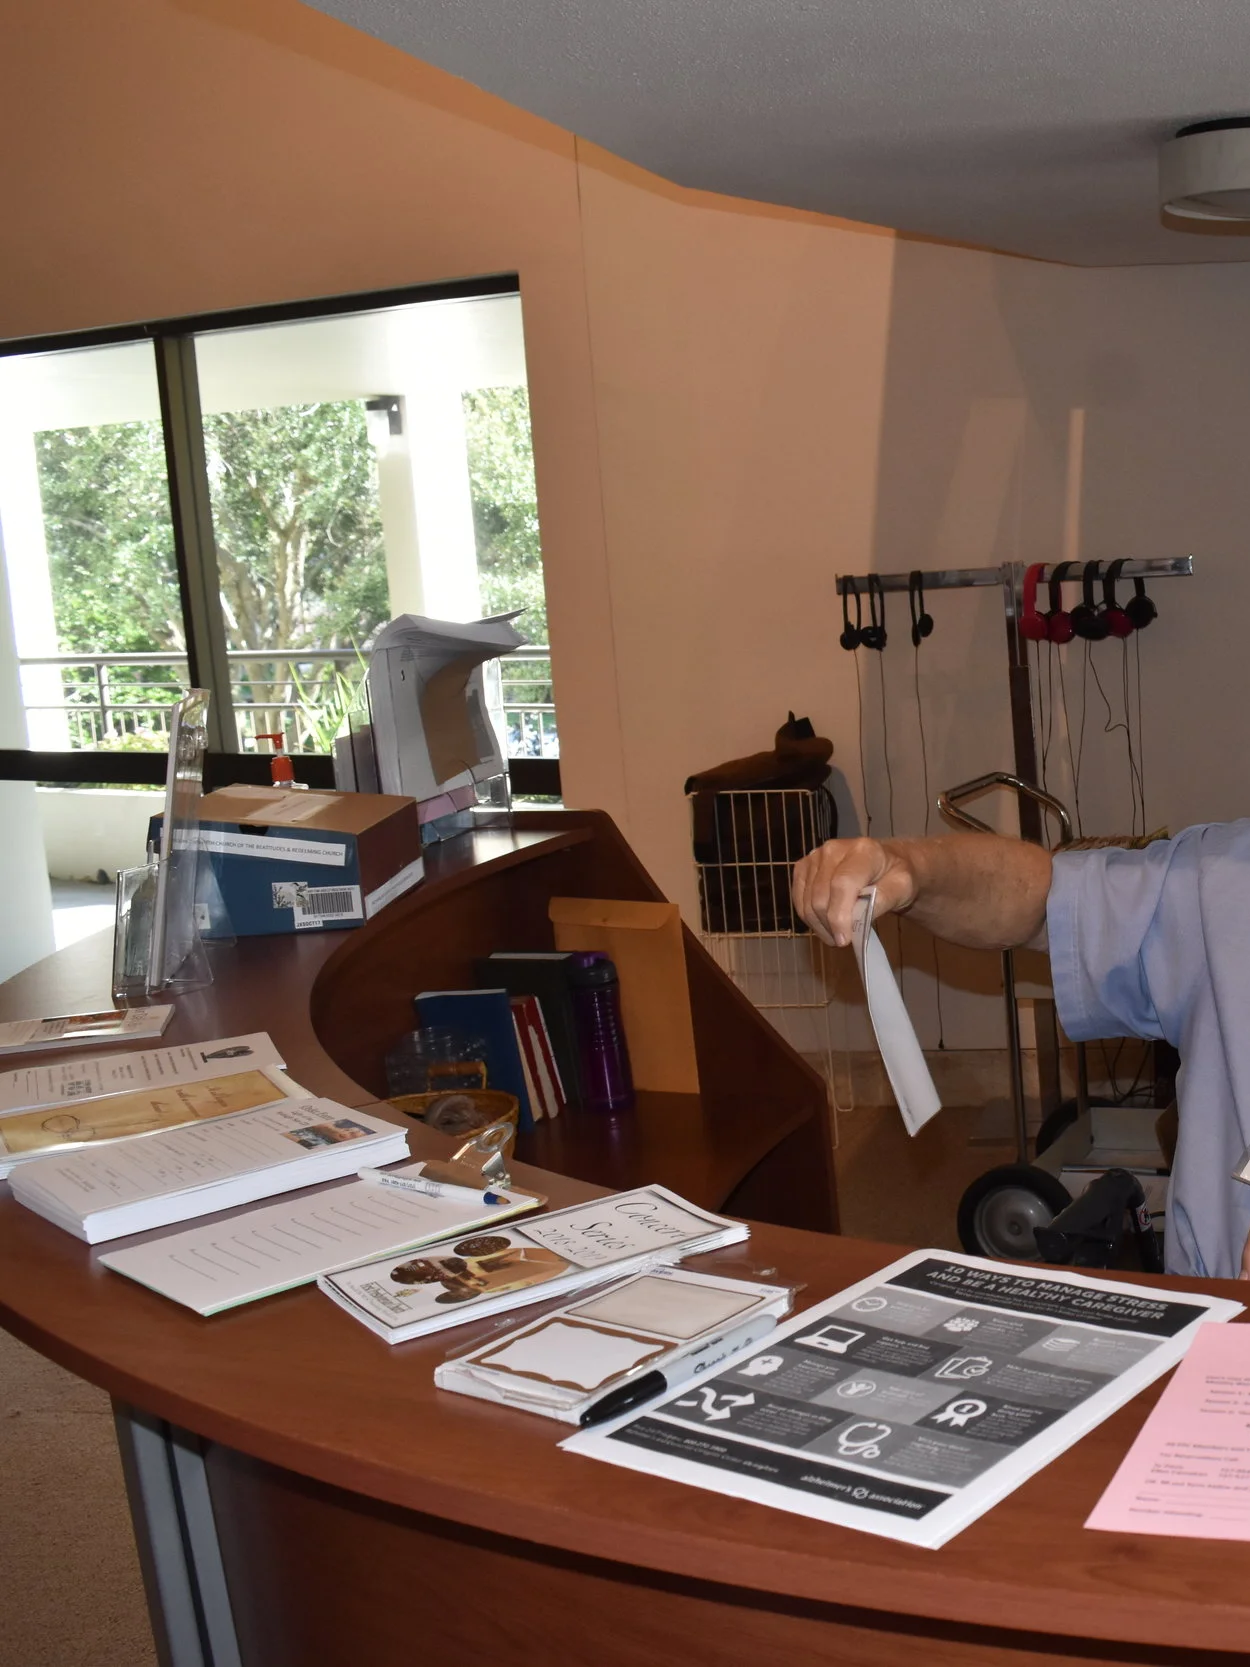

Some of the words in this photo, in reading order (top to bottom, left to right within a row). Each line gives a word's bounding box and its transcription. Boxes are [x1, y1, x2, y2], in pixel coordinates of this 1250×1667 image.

[926, 1271, 962, 1283] AND
[962, 1279, 984, 1288] BE
[984, 1283, 996, 1291] A
[997, 1286, 1071, 1303] HEALTHY
[1071, 1298, 1165, 1320] CAREGIVER
[944, 1265, 964, 1274] 10
[966, 1271, 1012, 1284] WAYS
[1014, 1279, 1036, 1288] TO
[1037, 1282, 1106, 1300] MANAGE
[1106, 1295, 1169, 1311] STRESS
